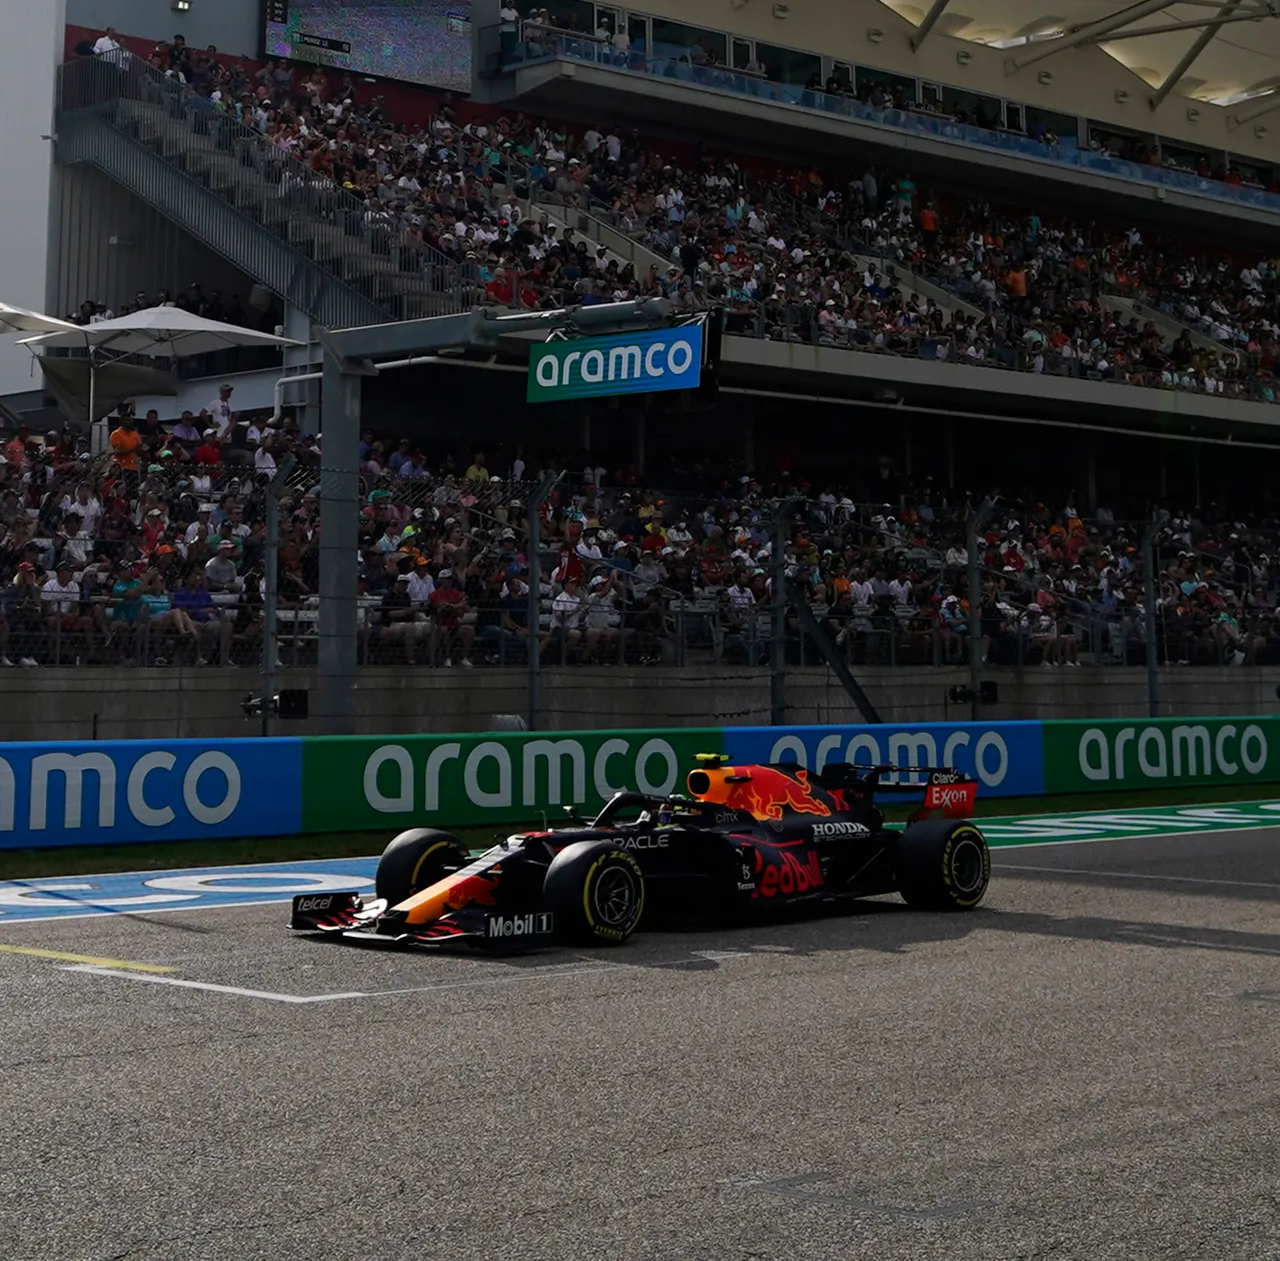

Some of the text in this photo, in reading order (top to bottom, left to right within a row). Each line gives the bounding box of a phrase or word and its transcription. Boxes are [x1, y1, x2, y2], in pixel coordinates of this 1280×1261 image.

[536, 340, 692, 386] aramco
[1079, 725, 1267, 780] aramco
[364, 738, 678, 812] aramco
[932, 770, 958, 784] Claro
[932, 786, 967, 810] Exxon
[811, 821, 870, 836] HONDA
[602, 834, 671, 850] RACLE
[296, 894, 334, 912] telcel
[489, 913, 534, 937] Mobil
